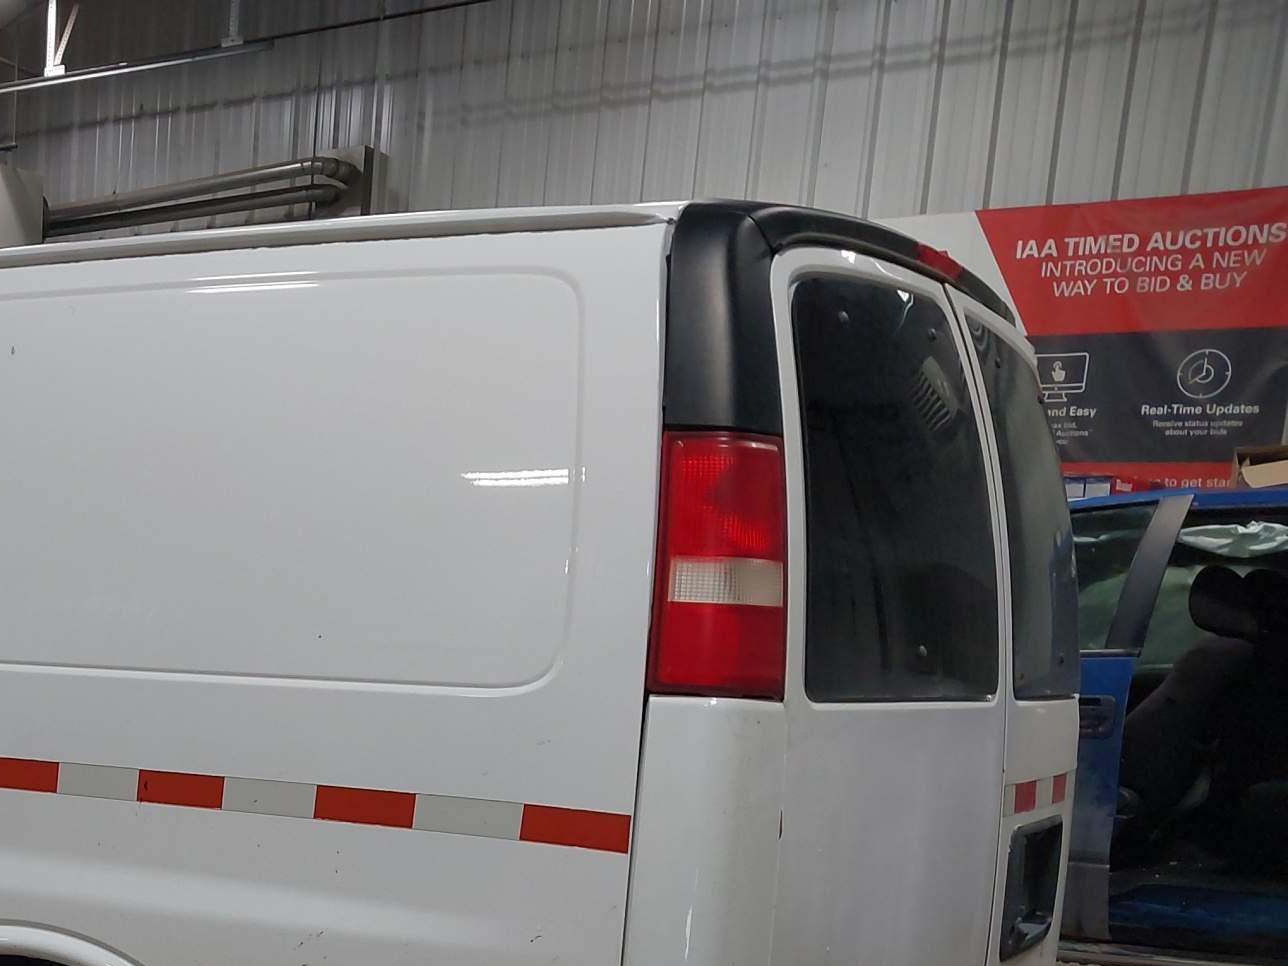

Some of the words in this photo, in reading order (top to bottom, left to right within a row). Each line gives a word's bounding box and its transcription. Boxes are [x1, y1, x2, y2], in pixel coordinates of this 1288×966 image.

[1015, 239, 1058, 259] IAA
[1064, 232, 1140, 257] TIMED
[1146, 222, 1288, 251] AUCTIONS
[1041, 254, 1183, 278] INTRODUCING
[1189, 252, 1205, 270] A
[1212, 248, 1268, 269] NEW
[1053, 280, 1097, 297] WAY
[1102, 276, 1129, 295] TO
[1136, 275, 1171, 293] BID
[1176, 274, 1193, 292] &
[1200, 271, 1248, 290] BUY
[1069, 405, 1097, 419] Easy
[1141, 403, 1203, 416] Real-Time
[1206, 402, 1261, 416] Updates
[1164, 477, 1177, 489] to
